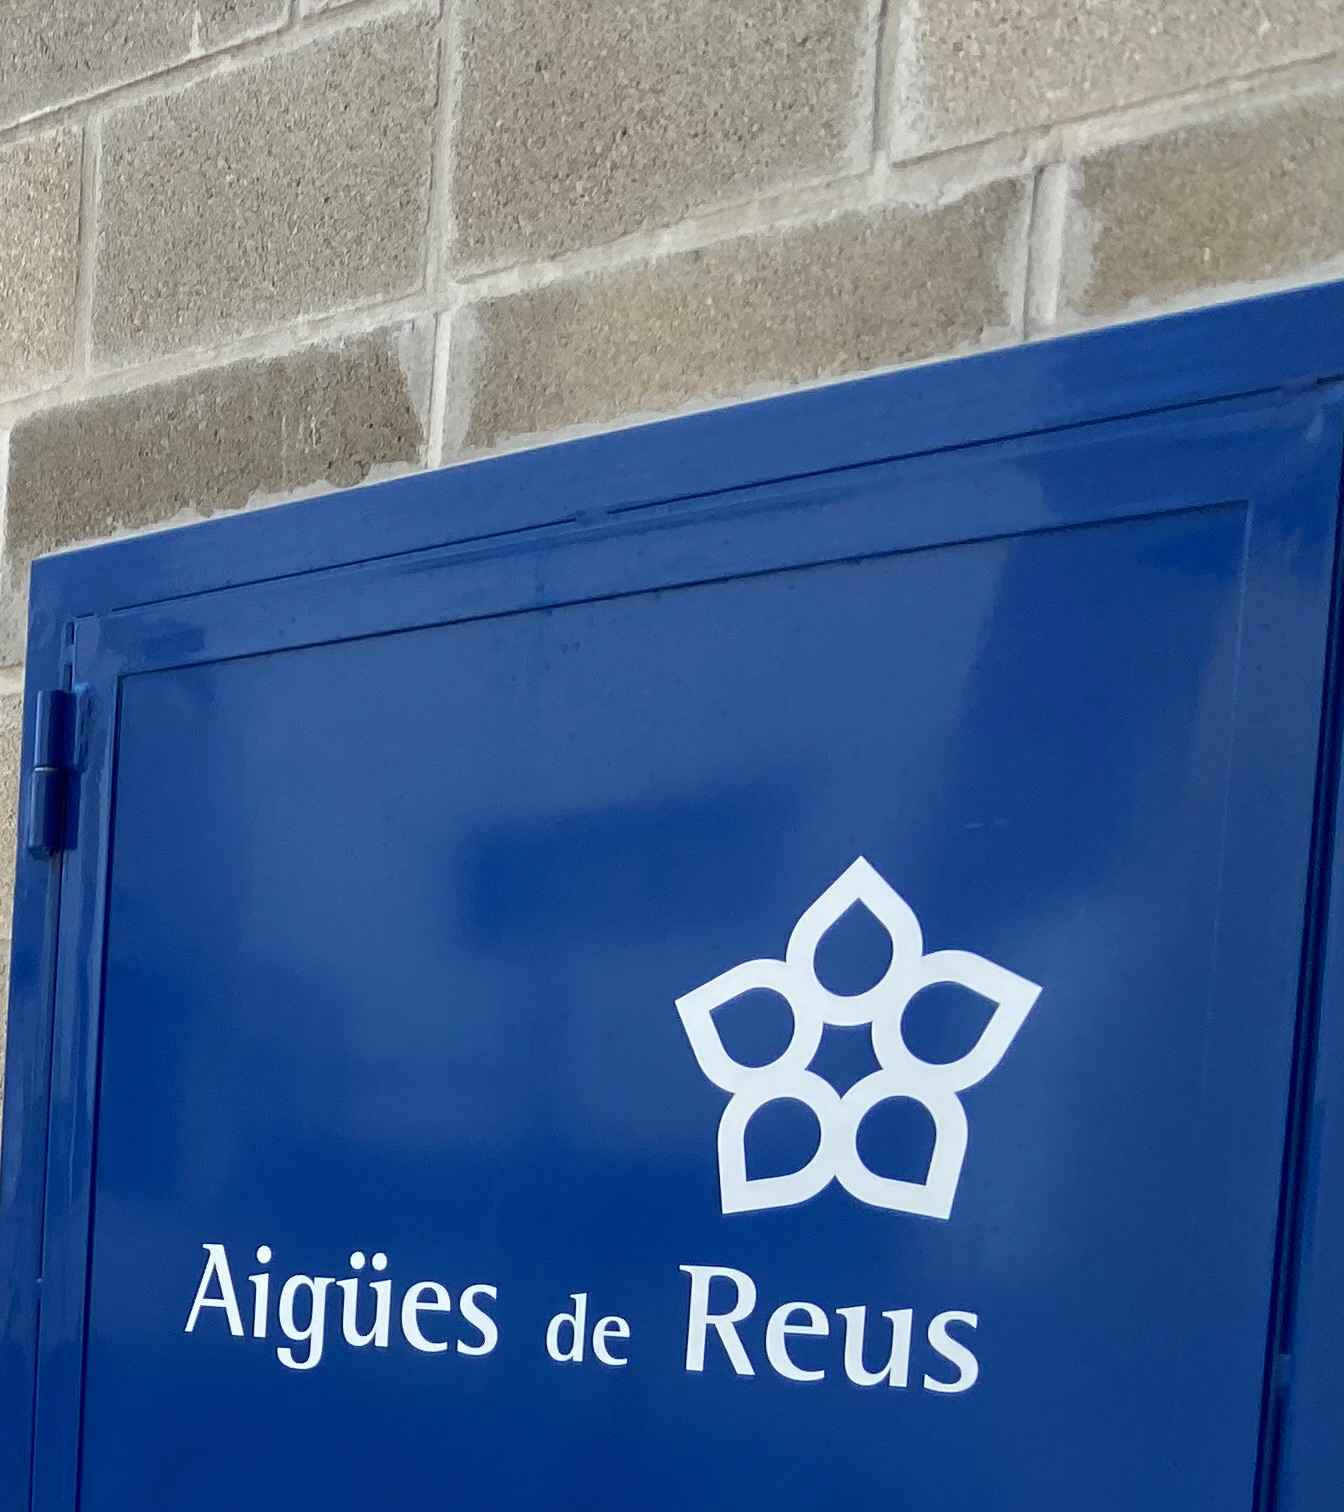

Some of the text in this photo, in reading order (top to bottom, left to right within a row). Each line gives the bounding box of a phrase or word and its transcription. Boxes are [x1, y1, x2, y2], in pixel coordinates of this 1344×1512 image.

[183, 1243, 980, 1394] Aigües de Reus
